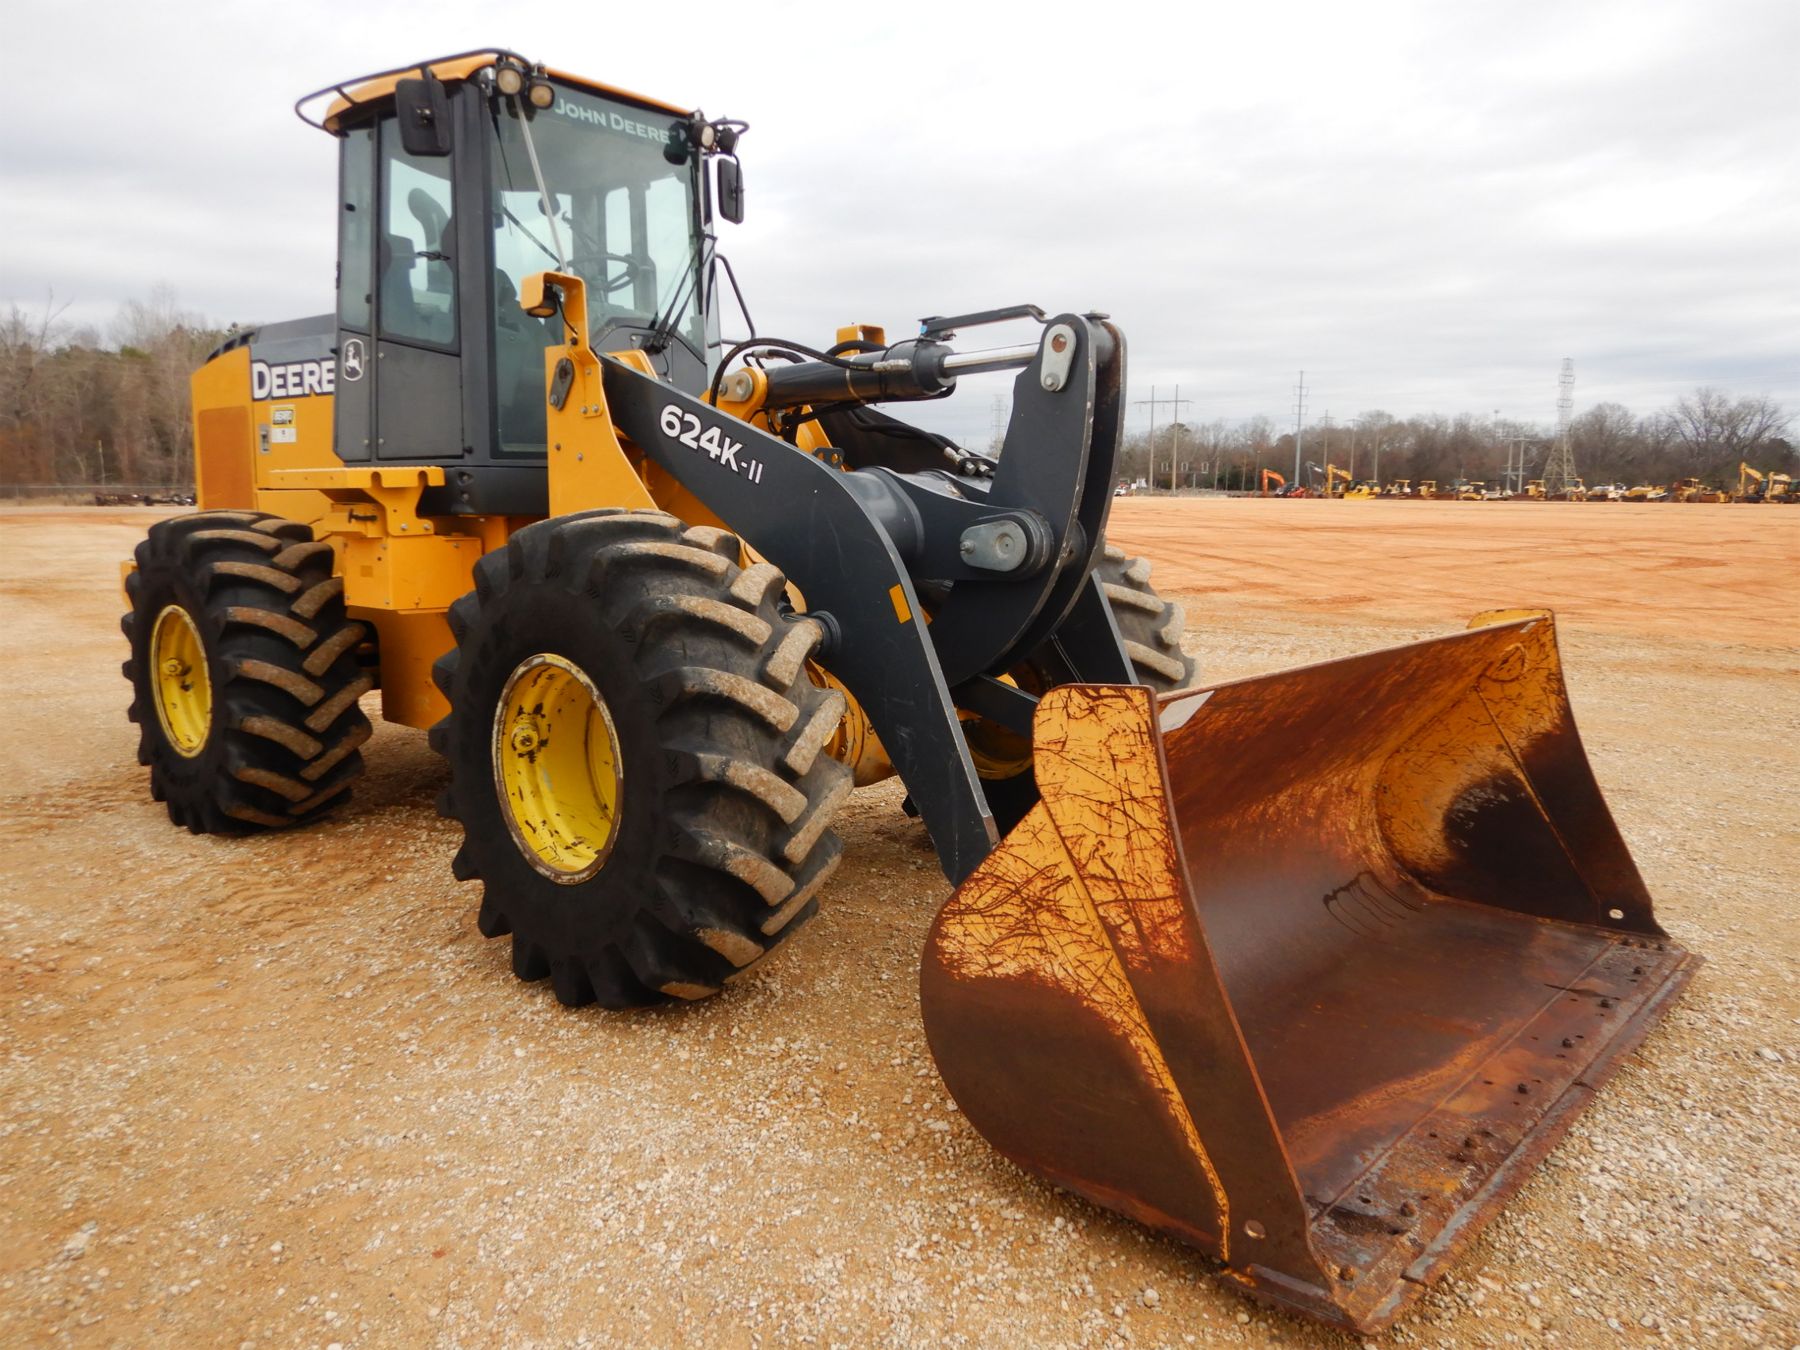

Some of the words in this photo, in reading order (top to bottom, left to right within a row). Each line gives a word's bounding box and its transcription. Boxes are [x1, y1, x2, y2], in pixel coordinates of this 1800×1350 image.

[554, 98, 607, 127] JOHN
[609, 112, 671, 144] DEERE
[251, 359, 336, 401] DEERE
[660, 404, 763, 484] 624K-II
